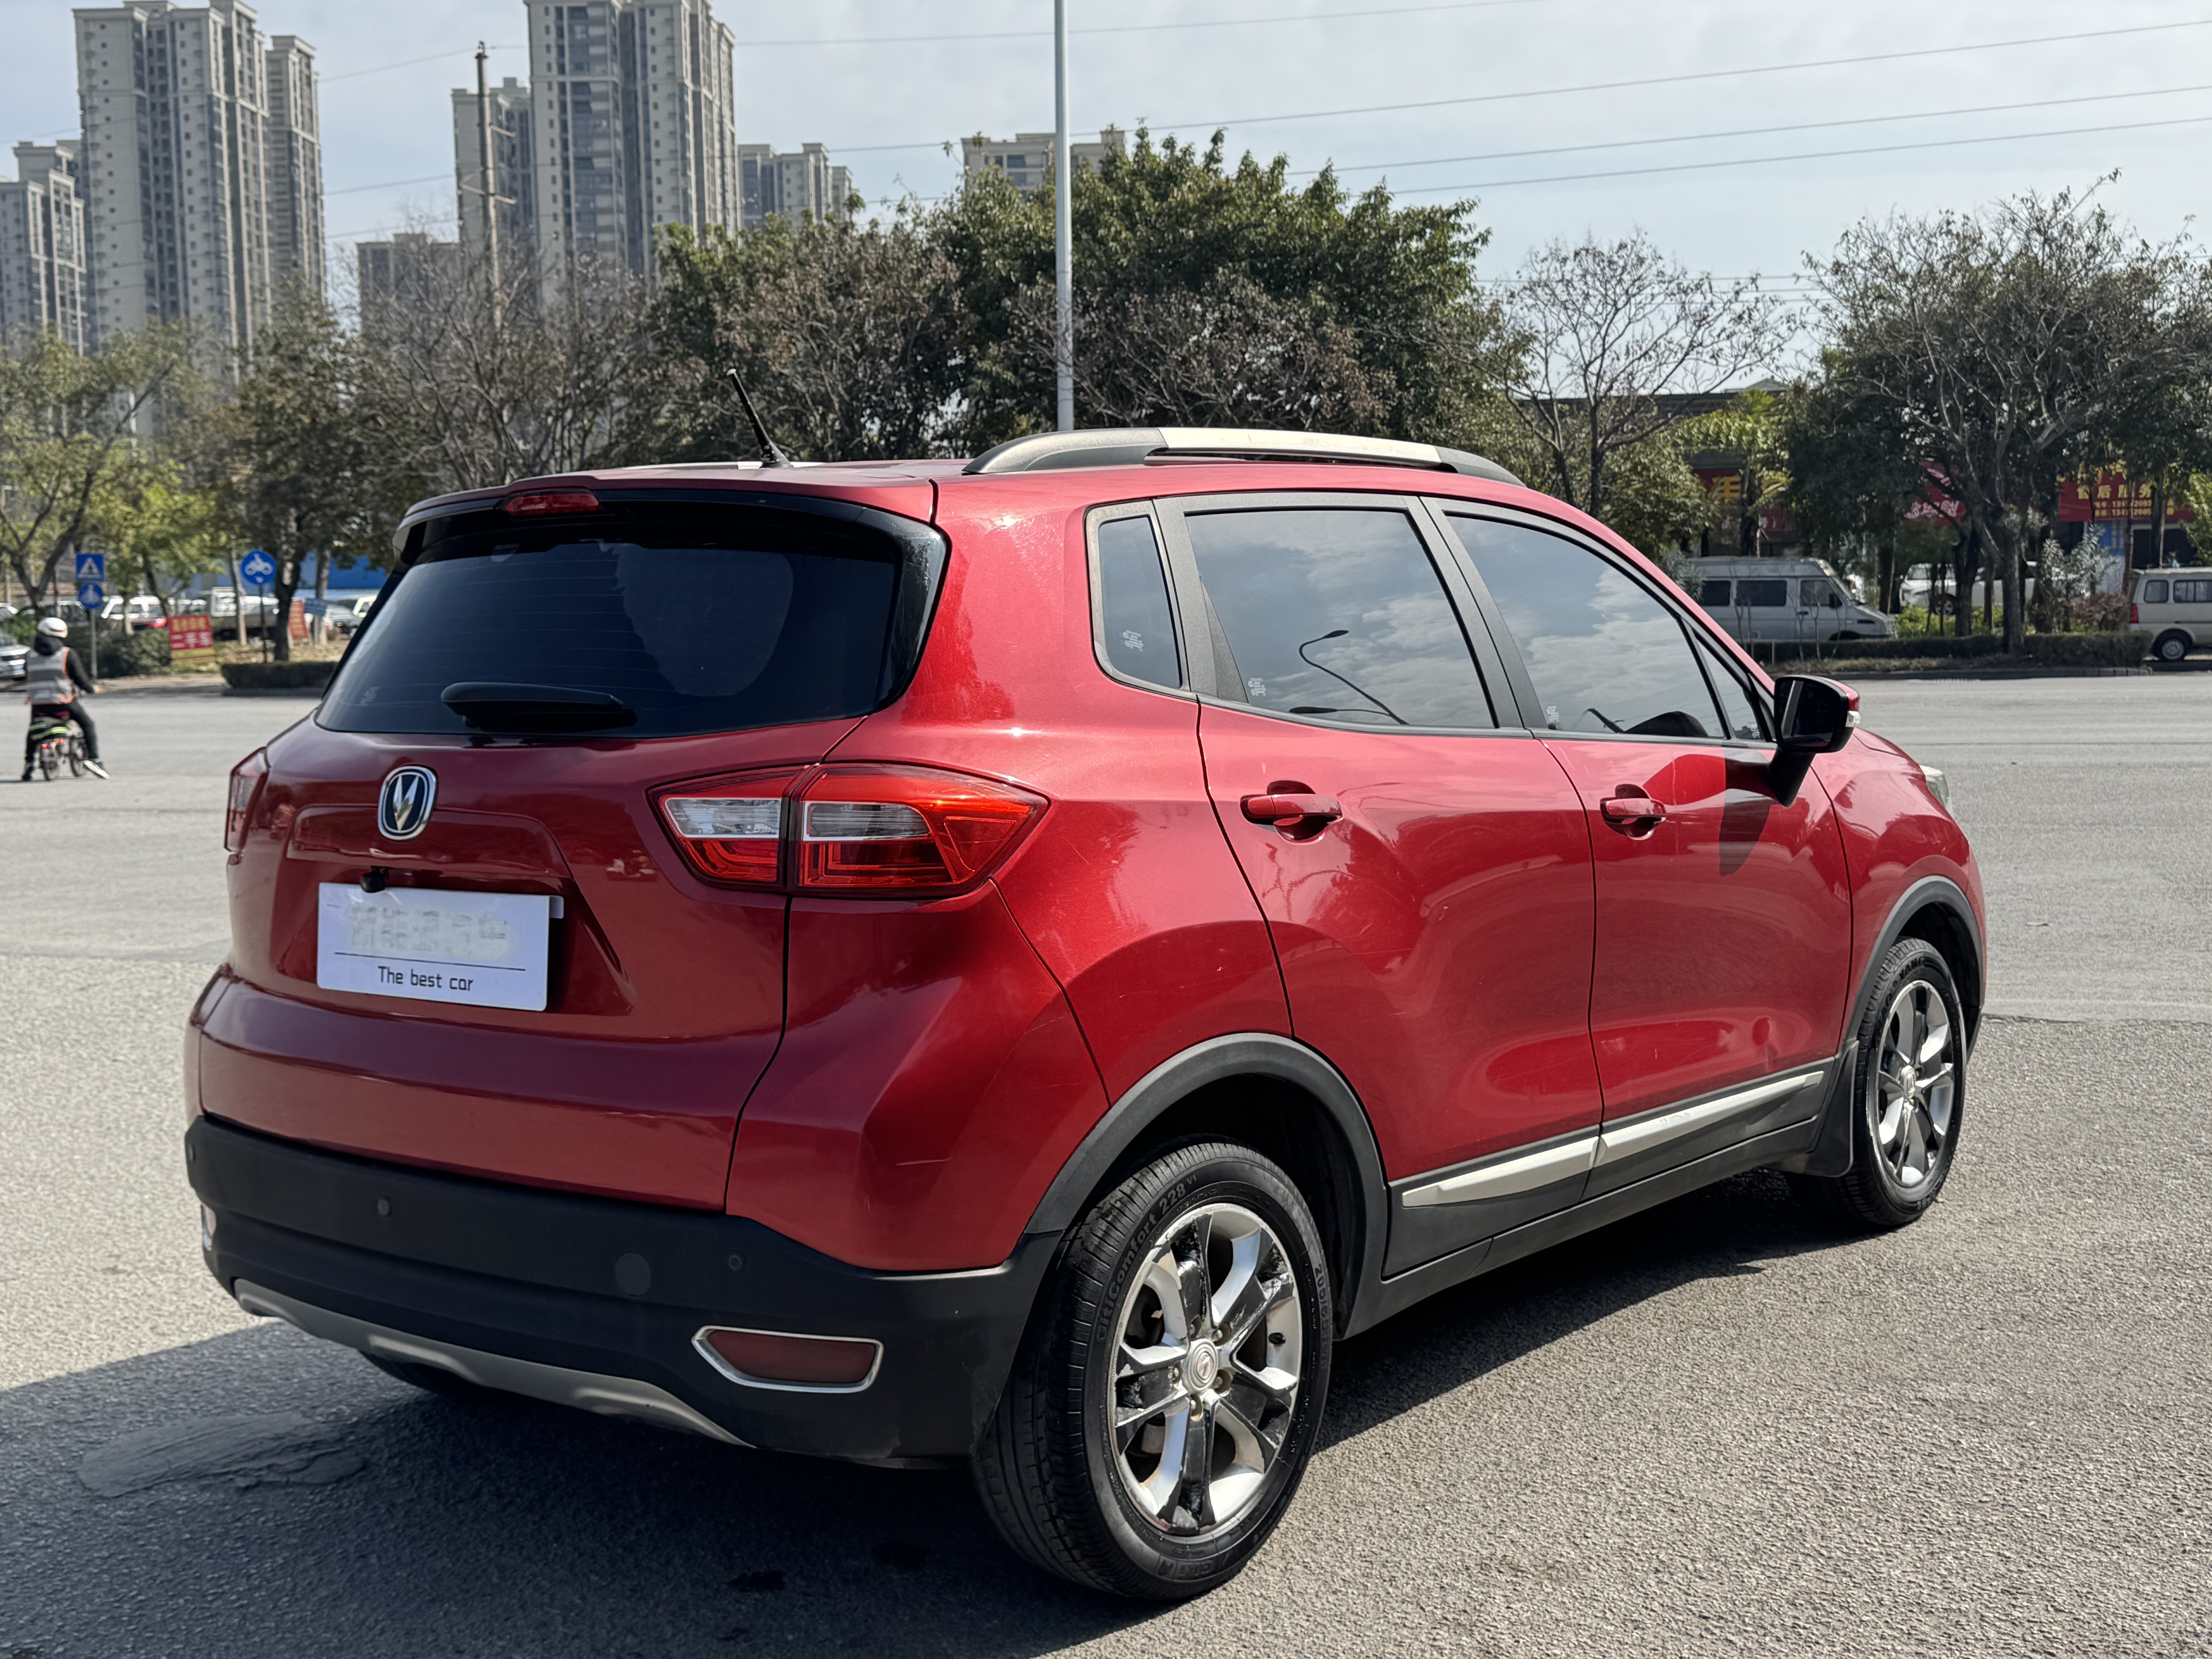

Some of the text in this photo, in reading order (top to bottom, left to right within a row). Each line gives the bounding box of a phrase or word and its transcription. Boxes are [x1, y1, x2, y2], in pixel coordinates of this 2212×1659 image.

[378, 965, 474, 991] The best car
[1159, 1182, 1186, 1216] 228
[1187, 1174, 1197, 1185] V1
